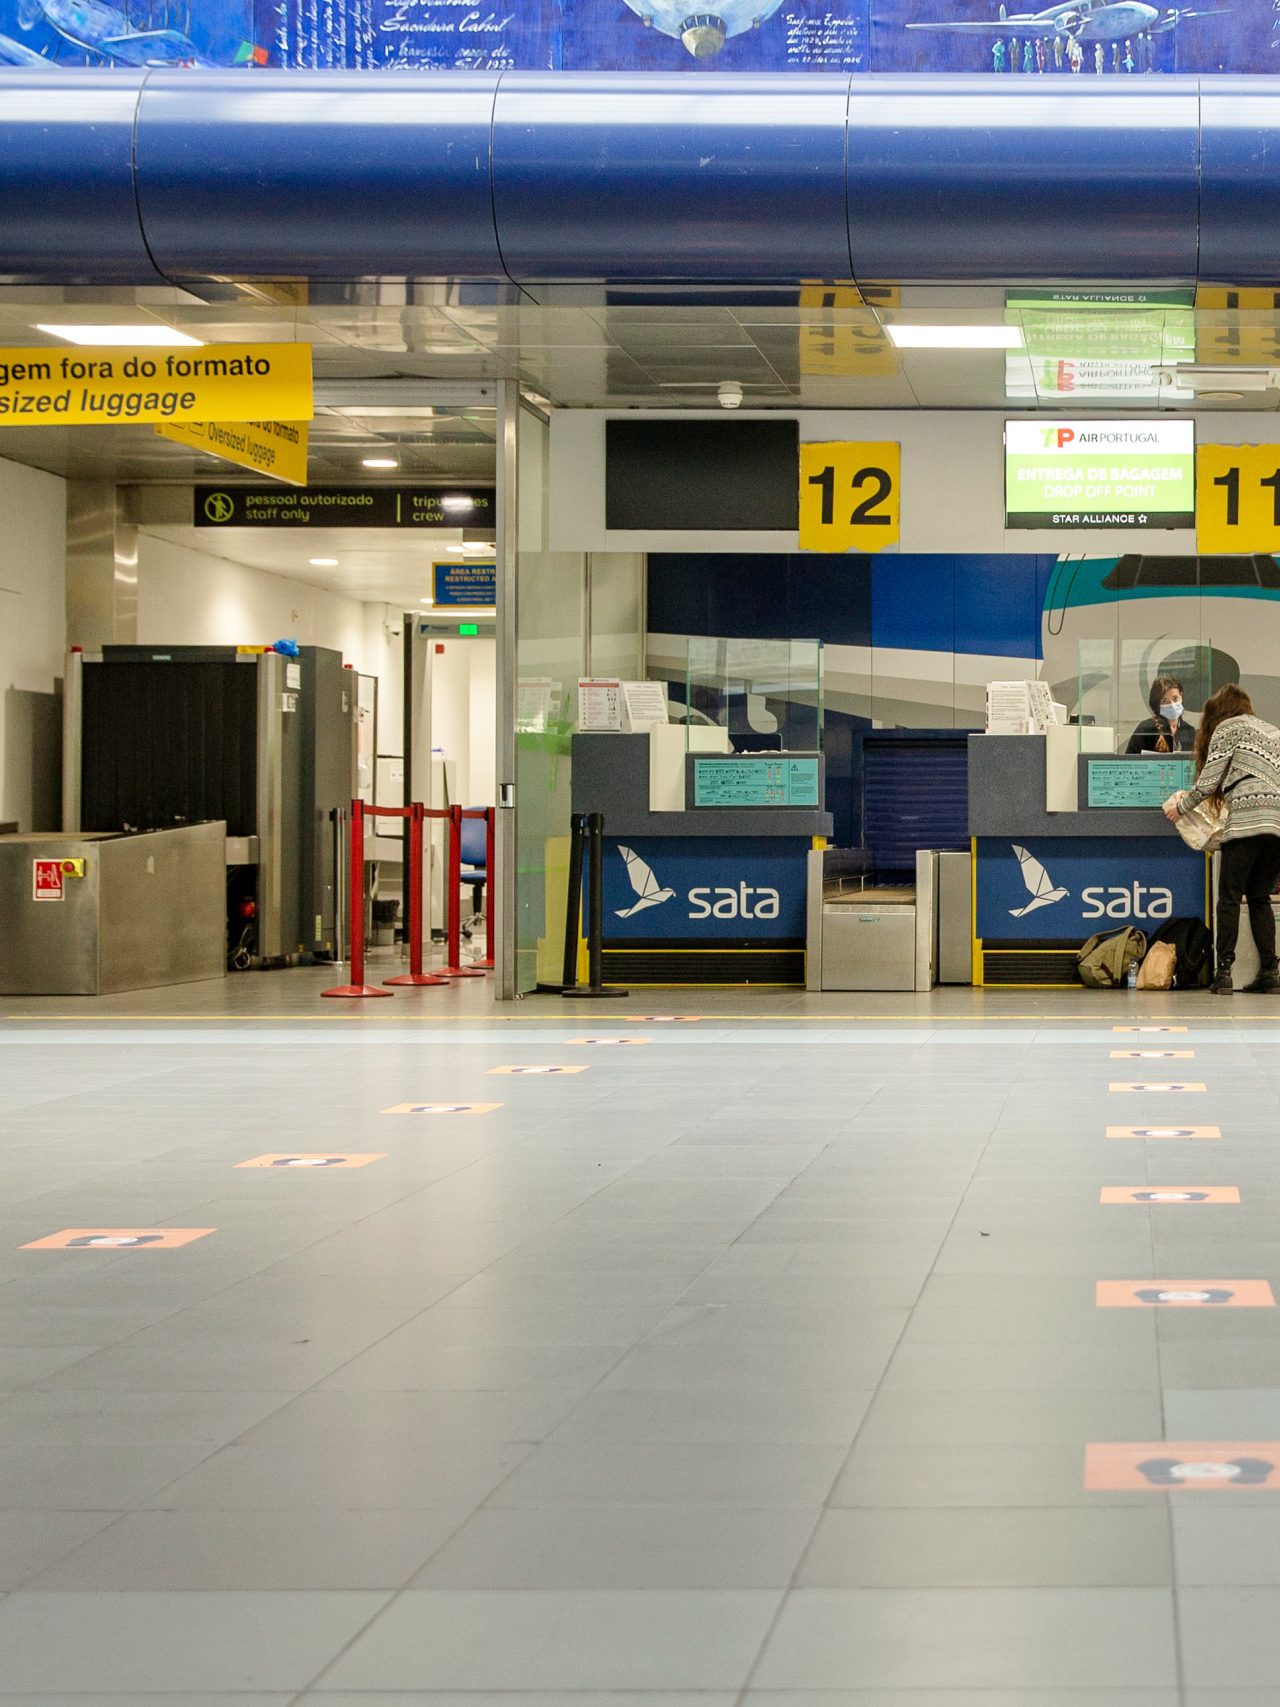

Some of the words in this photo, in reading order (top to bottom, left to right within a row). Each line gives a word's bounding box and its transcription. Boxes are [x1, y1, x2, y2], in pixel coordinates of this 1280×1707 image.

[60, 358, 113, 379] fora
[123, 356, 157, 378] do
[166, 355, 271, 377] formato
[80, 390, 196, 417] luggage
[208, 421, 246, 453] Oversized
[247, 435, 275, 467] luggage
[1017, 467, 1084, 481] ENTREGA
[1088, 467, 1106, 481] DE
[1110, 467, 1183, 481] BAGAGEM
[808, 466, 892, 525] 12
[1043, 484, 1081, 498] DROP
[1085, 484, 1112, 498] OFF
[1116, 484, 1157, 498] POINT
[246, 495, 297, 507] pessoal
[301, 495, 374, 505] autorizado
[246, 509, 277, 520] staff
[281, 509, 310, 522] only
[413, 512, 444, 521] crew
[1052, 514, 1080, 524] STAR
[1082, 514, 1135, 524] ALLIANCE
[688, 880, 780, 919] sata
[1081, 880, 1173, 919] sata
